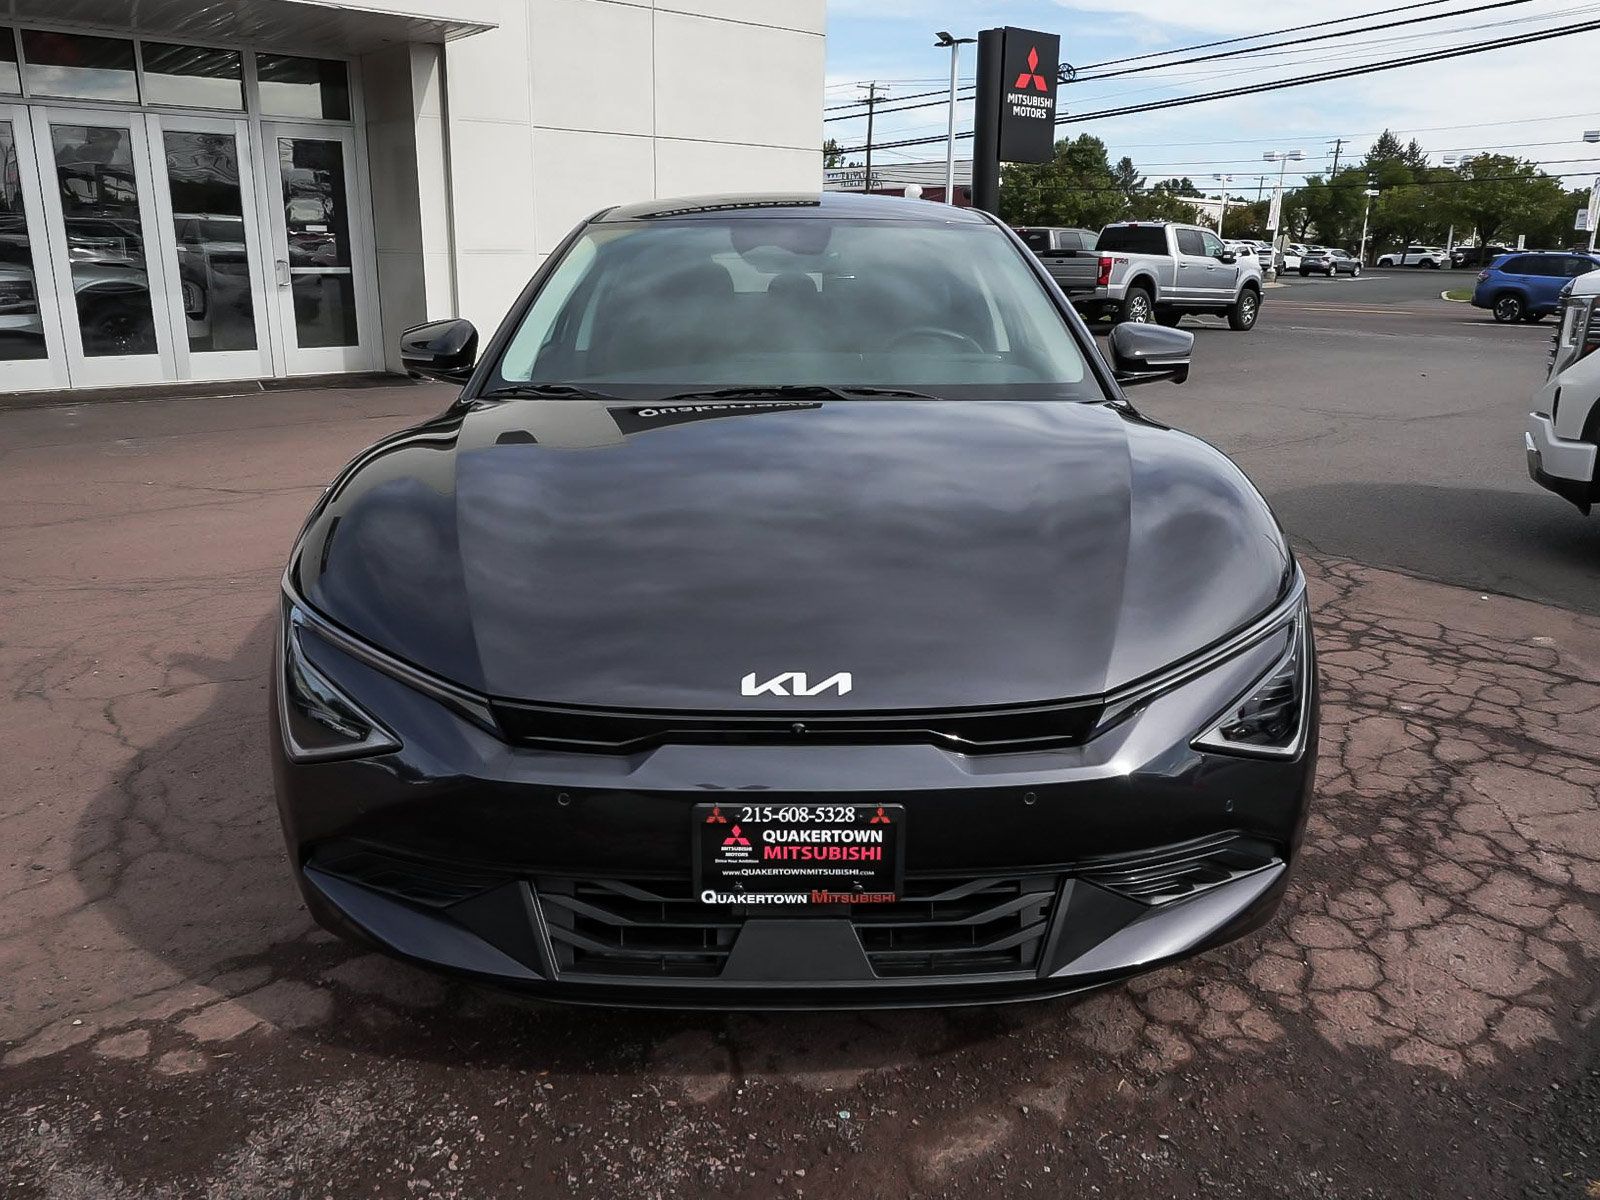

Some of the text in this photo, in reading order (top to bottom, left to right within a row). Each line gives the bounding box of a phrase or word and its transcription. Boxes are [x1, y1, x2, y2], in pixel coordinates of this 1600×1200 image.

[1007, 93, 1053, 109] MITSUBISHI
[1012, 107, 1047, 119] MOTORS
[741, 672, 852, 696] KIA
[741, 807, 855, 823] 215-608-5328
[762, 829, 883, 844] QUAKERTOWN
[763, 846, 882, 861] MITSUBISHI
